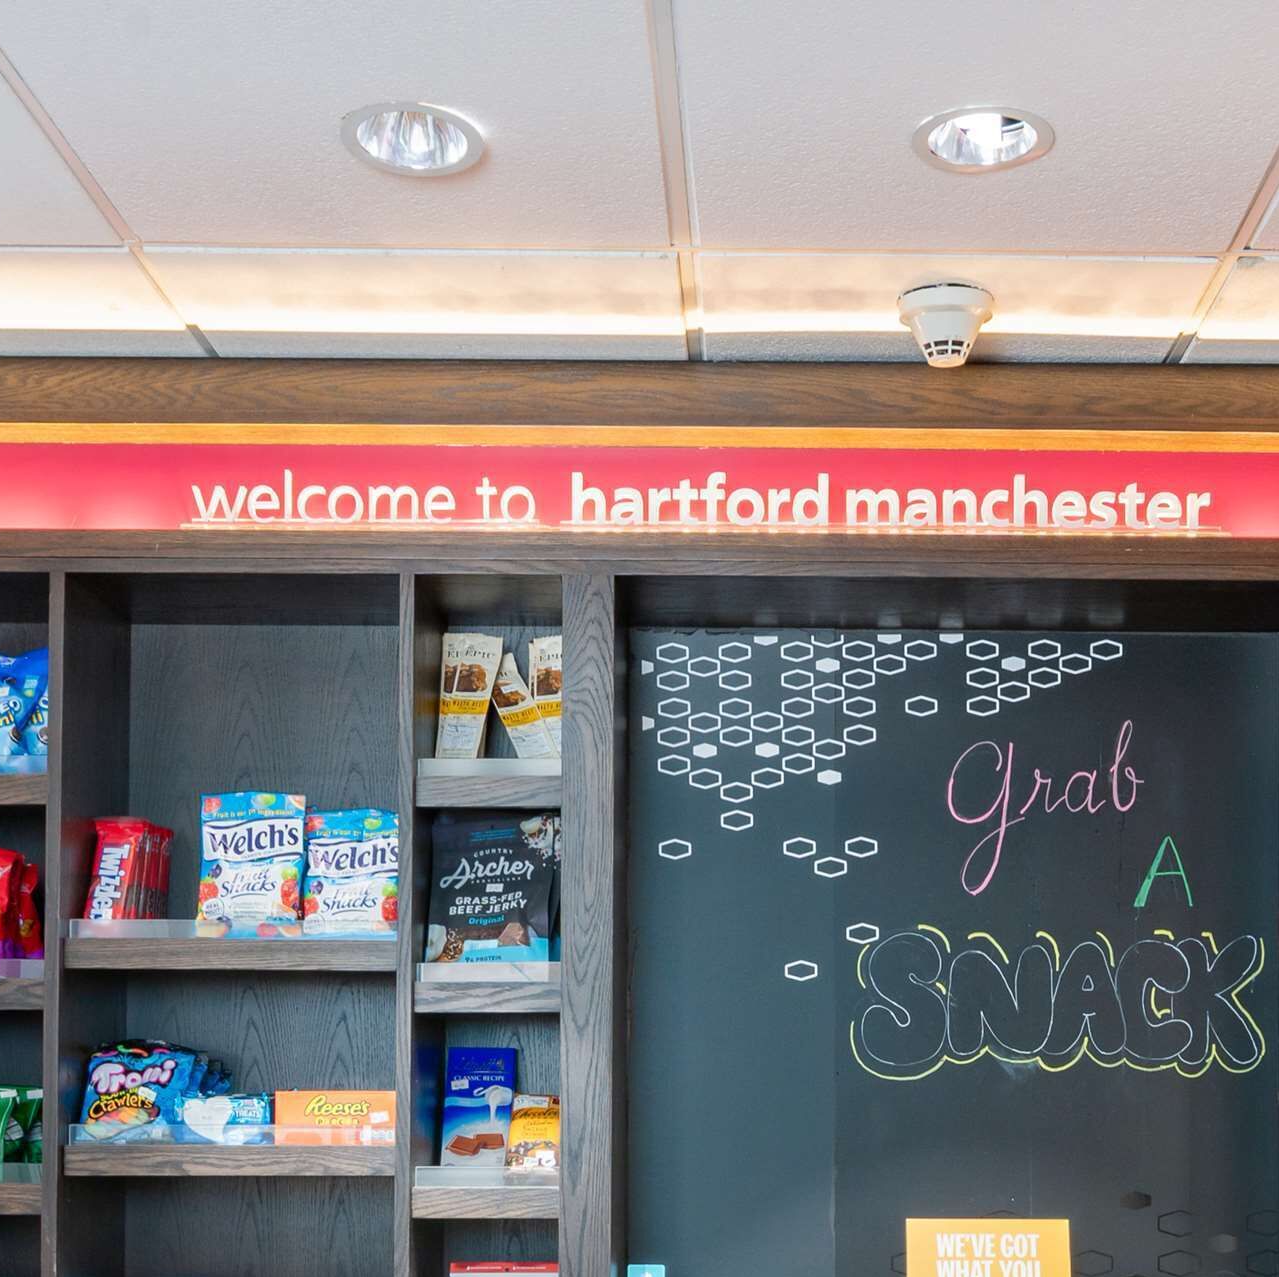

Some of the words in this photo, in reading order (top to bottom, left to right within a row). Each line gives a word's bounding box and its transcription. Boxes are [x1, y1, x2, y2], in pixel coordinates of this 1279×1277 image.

[191, 469, 456, 524] welcome
[476, 477, 536, 524] to
[571, 471, 829, 527] hartford
[846, 473, 1211, 530] manchester
[209, 823, 300, 856] Welch's
[473, 848, 513, 858] COUNTRY
[309, 842, 399, 871] Welch's
[89, 844, 131, 921] Twizzler
[440, 856, 535, 889] Archer
[1133, 835, 1193, 908] A
[449, 904, 482, 916] BEEF
[486, 898, 528, 914] JERKY
[455, 891, 523, 905] GRASS-FED
[468, 915, 505, 926] Original
[851, 924, 1265, 1081] SNACK
[90, 1059, 177, 1094] Trolli
[88, 1092, 154, 1119] Crawlers
[304, 1094, 370, 1116] Reese's
[936, 1233, 995, 1258] WE'VE
[999, 1233, 1040, 1258] GOT
